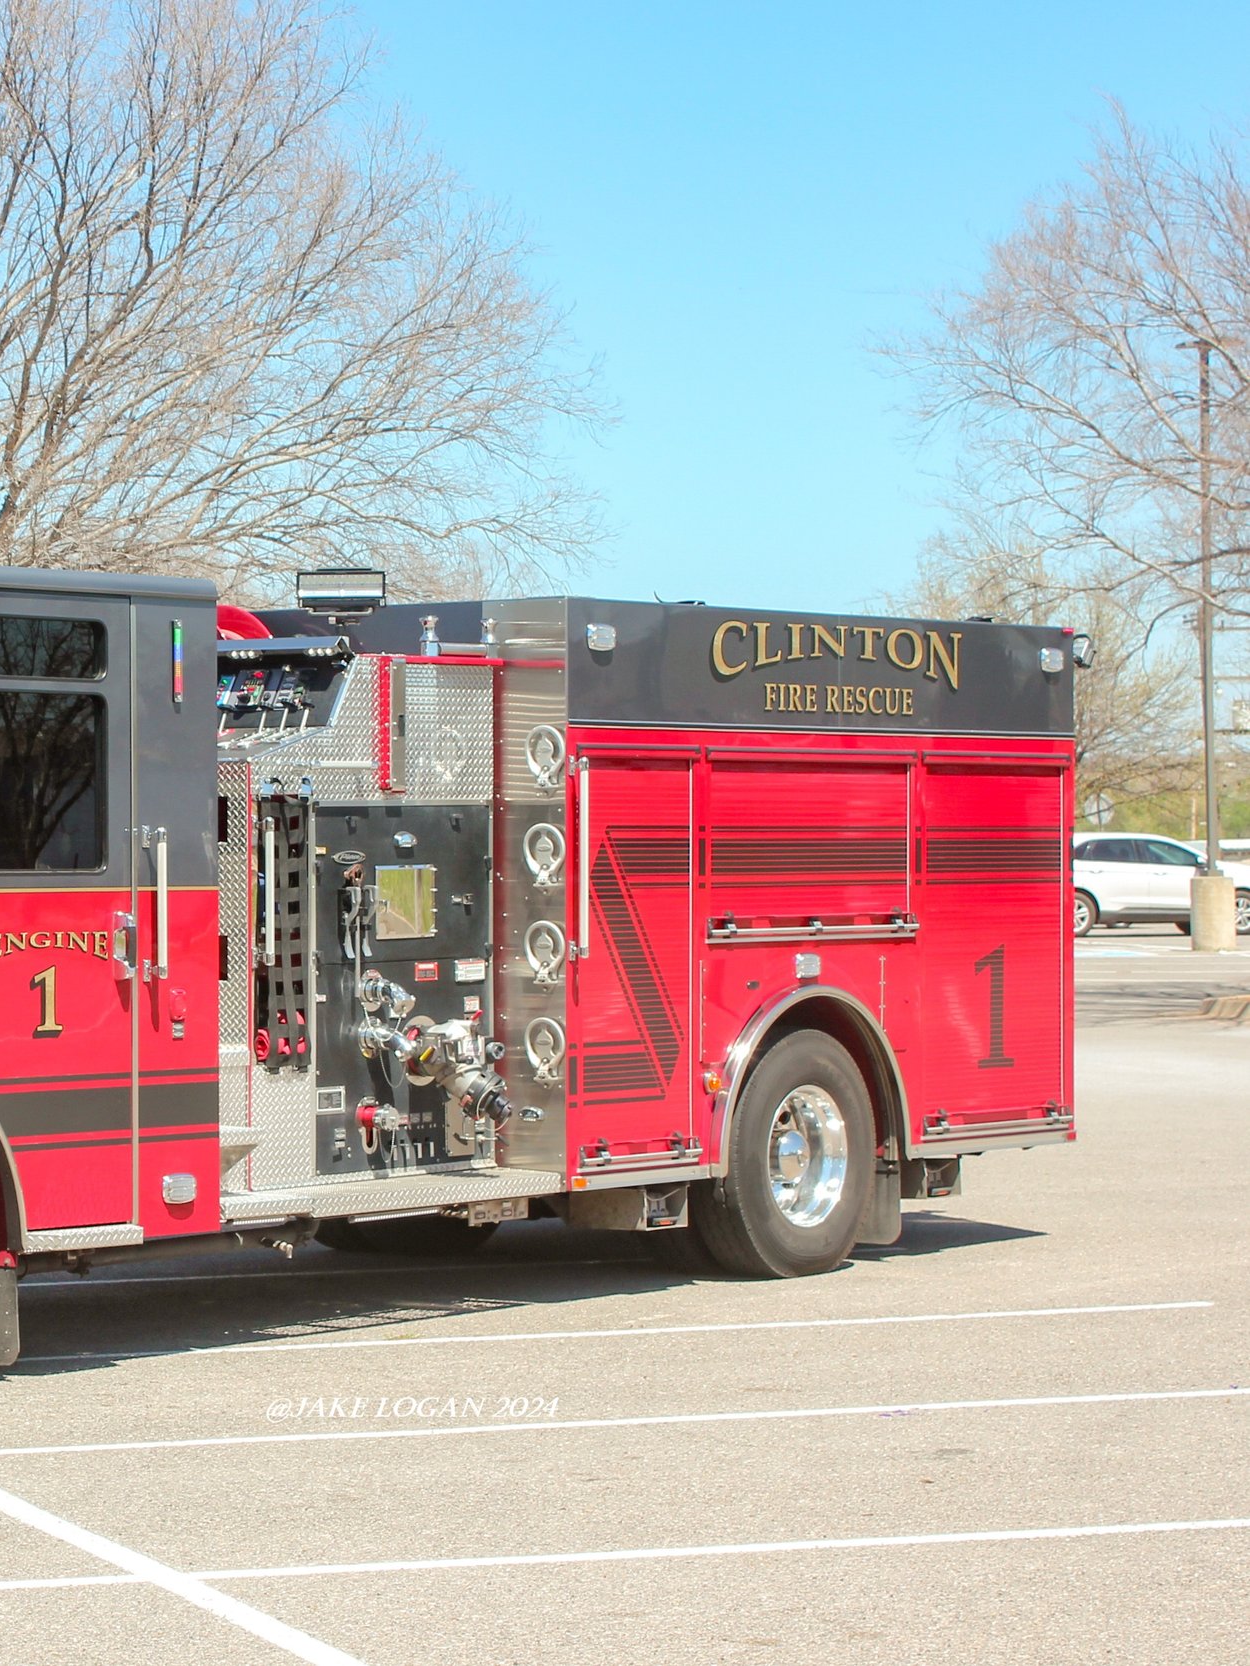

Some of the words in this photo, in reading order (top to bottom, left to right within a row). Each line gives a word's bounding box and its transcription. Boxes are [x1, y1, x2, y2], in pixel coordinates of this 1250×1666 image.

[711, 620, 962, 690] CLINTON
[764, 683, 818, 712] FIRE
[826, 685, 914, 715] RESCUE
[31, 965, 64, 1037] 1
[974, 943, 1015, 1069] 1
